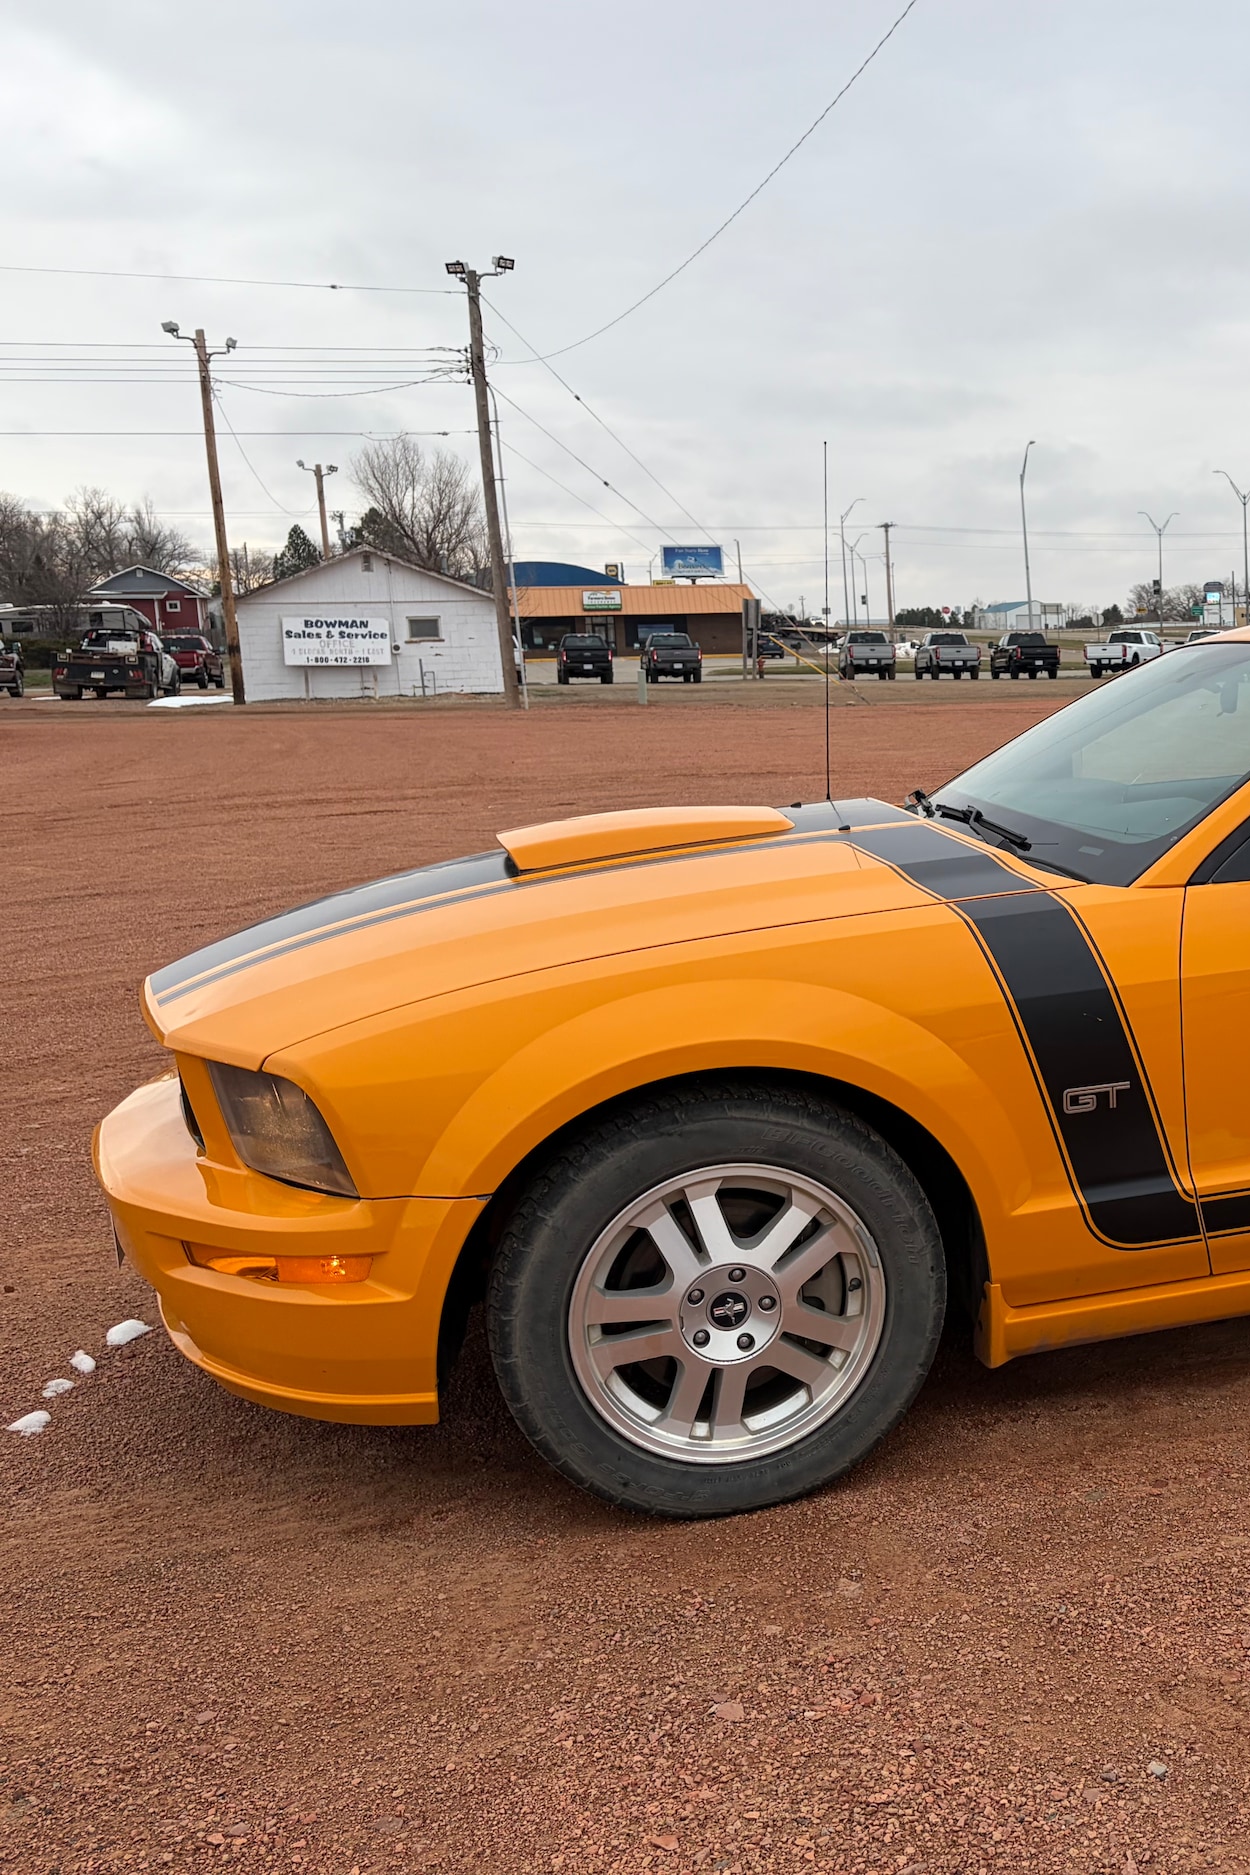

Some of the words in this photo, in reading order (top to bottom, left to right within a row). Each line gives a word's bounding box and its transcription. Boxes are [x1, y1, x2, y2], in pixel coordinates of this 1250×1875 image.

[304, 619, 369, 629] BOWMAN
[285, 629, 322, 639] Sales
[326, 630, 335, 639] &
[338, 630, 388, 639] Service
[319, 640, 355, 648] OFFICE
[1063, 1081, 1131, 1115] GT
